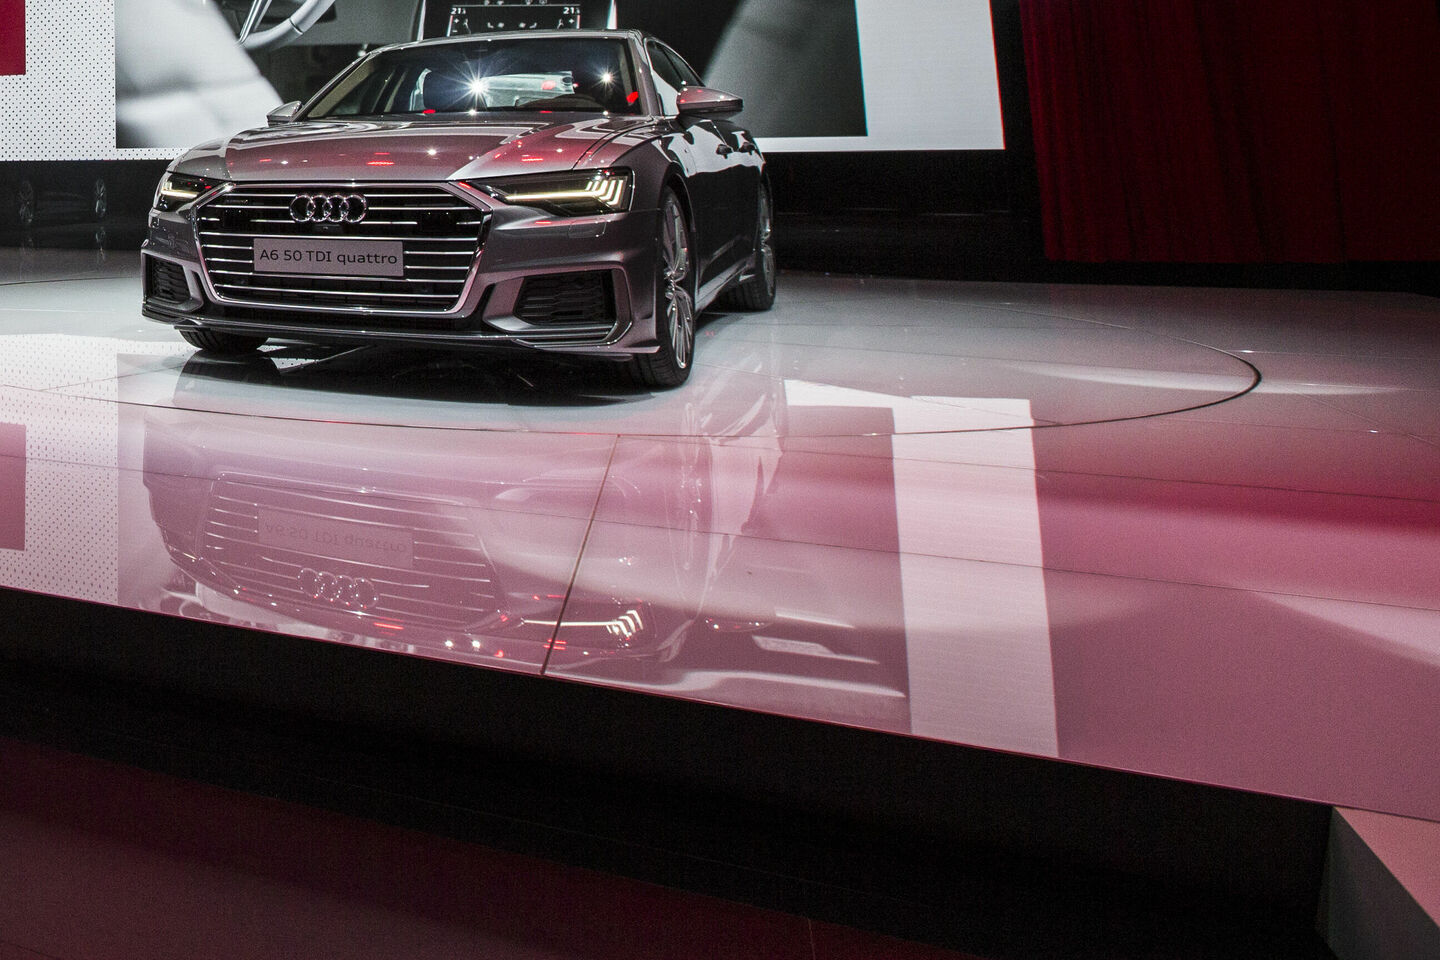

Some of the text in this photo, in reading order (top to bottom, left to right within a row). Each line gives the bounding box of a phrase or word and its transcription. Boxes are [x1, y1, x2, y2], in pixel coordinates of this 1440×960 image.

[260, 249, 398, 265] A6 50 TDI quattro
